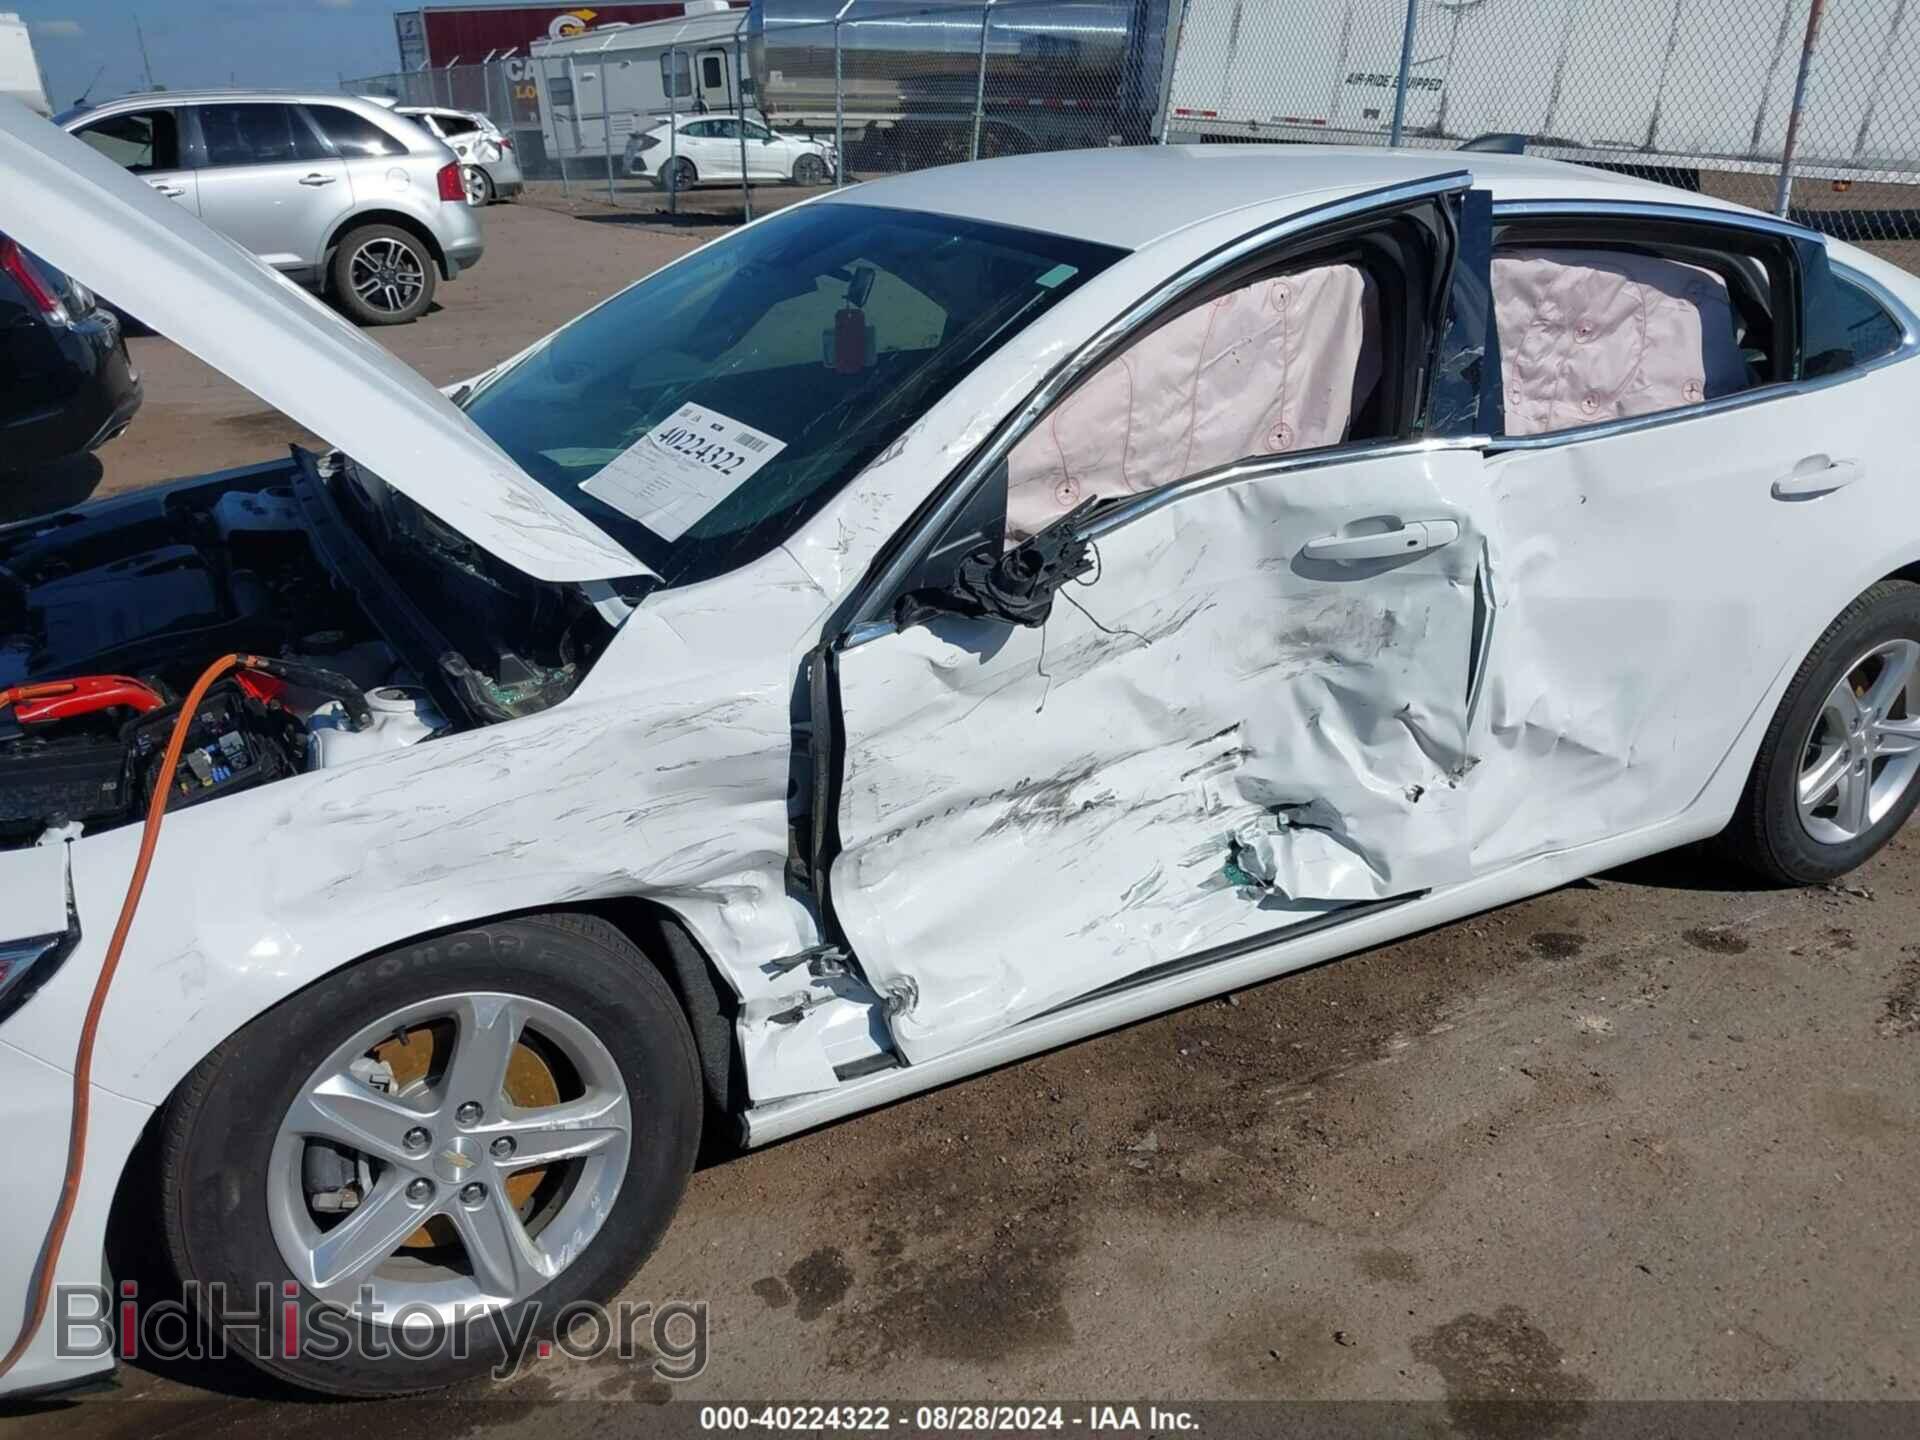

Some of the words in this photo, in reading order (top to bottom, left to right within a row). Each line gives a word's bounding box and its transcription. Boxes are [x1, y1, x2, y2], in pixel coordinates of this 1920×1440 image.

[504, 58, 537, 81] CA
[514, 85, 537, 99] LO
[1345, 72, 1392, 88] AIR-RIDE
[1392, 76, 1443, 92] EUIPPED
[659, 426, 746, 475] 40224322
